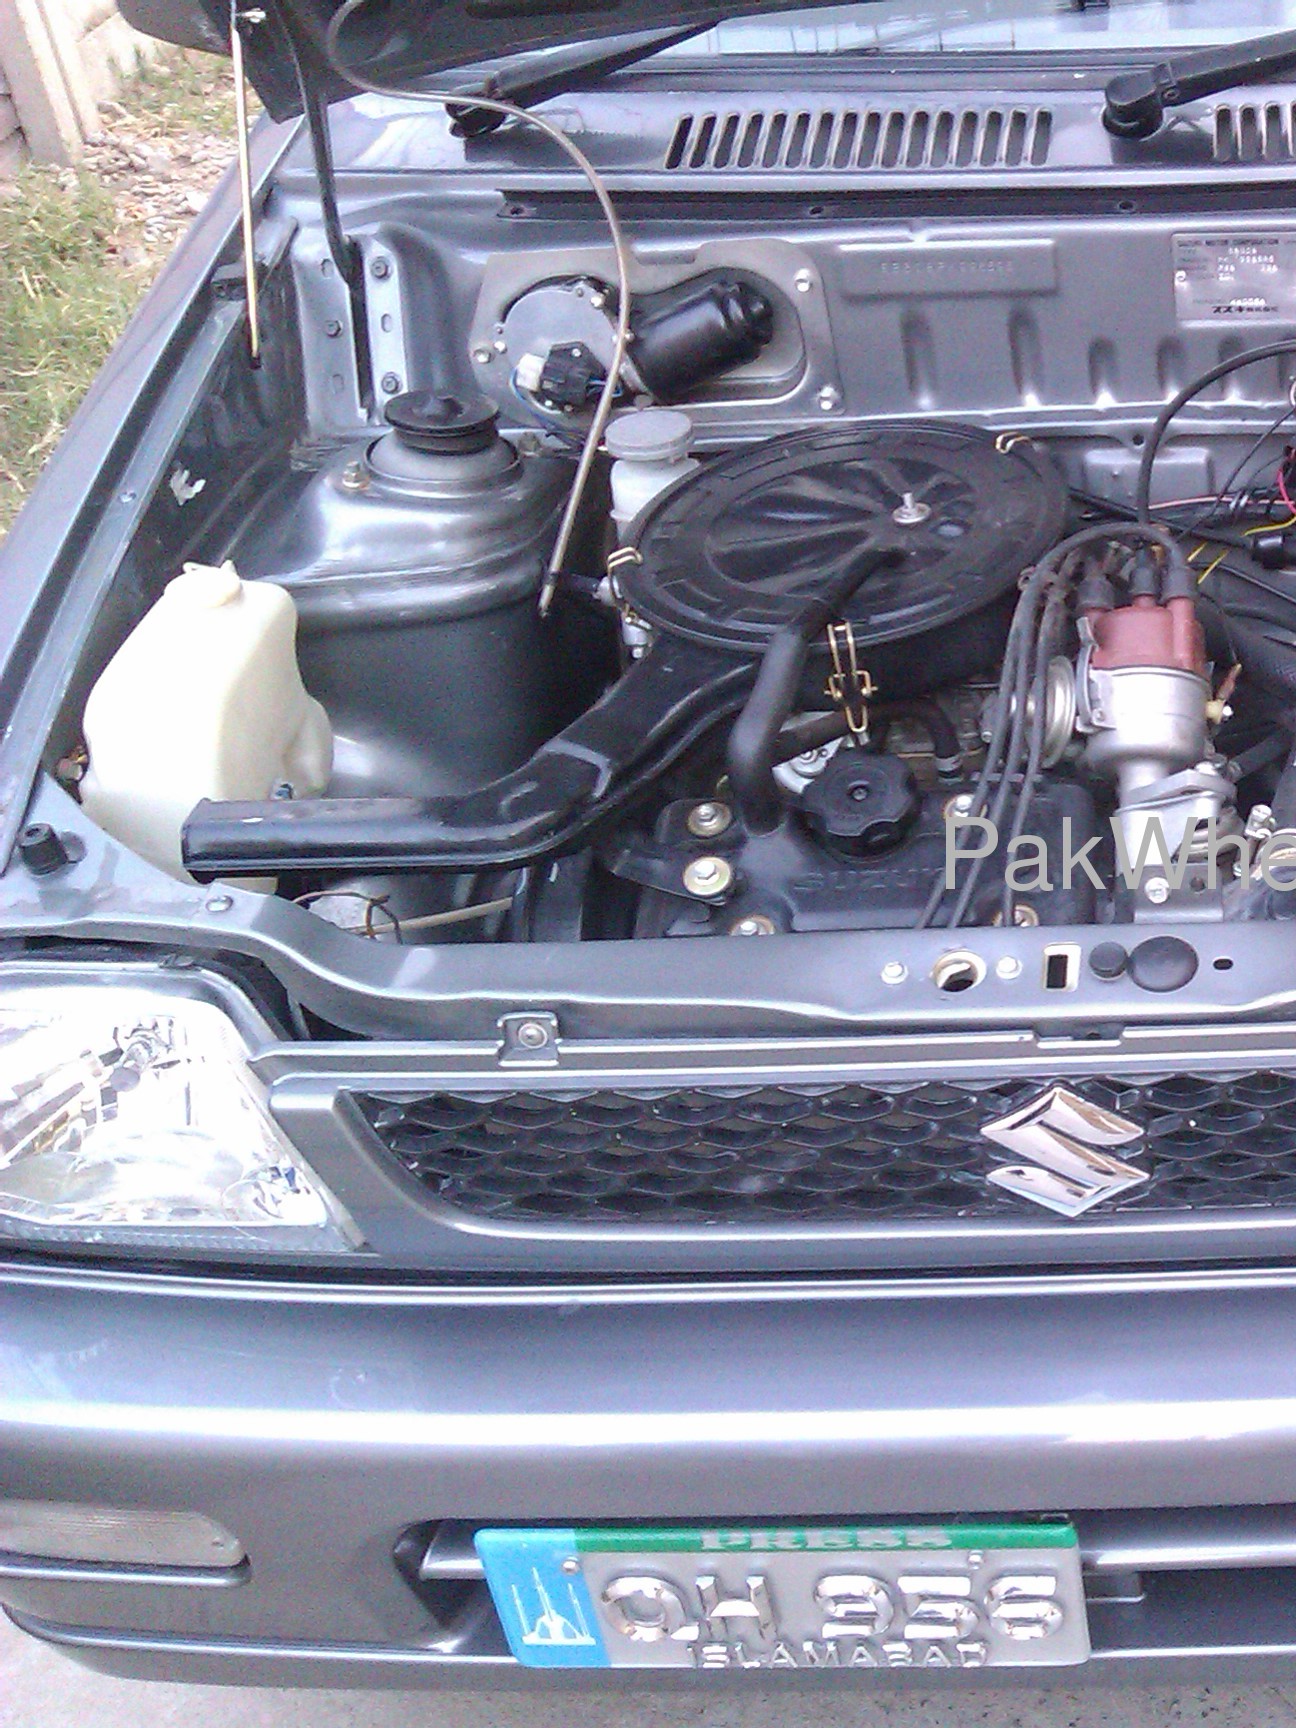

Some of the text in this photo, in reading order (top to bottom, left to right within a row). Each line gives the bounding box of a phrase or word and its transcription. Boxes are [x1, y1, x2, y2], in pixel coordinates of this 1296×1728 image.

[701, 1529, 952, 1549] PRESS
[814, 1575, 1063, 1641] 956
[687, 1642, 987, 1668] ISLAMABAD
